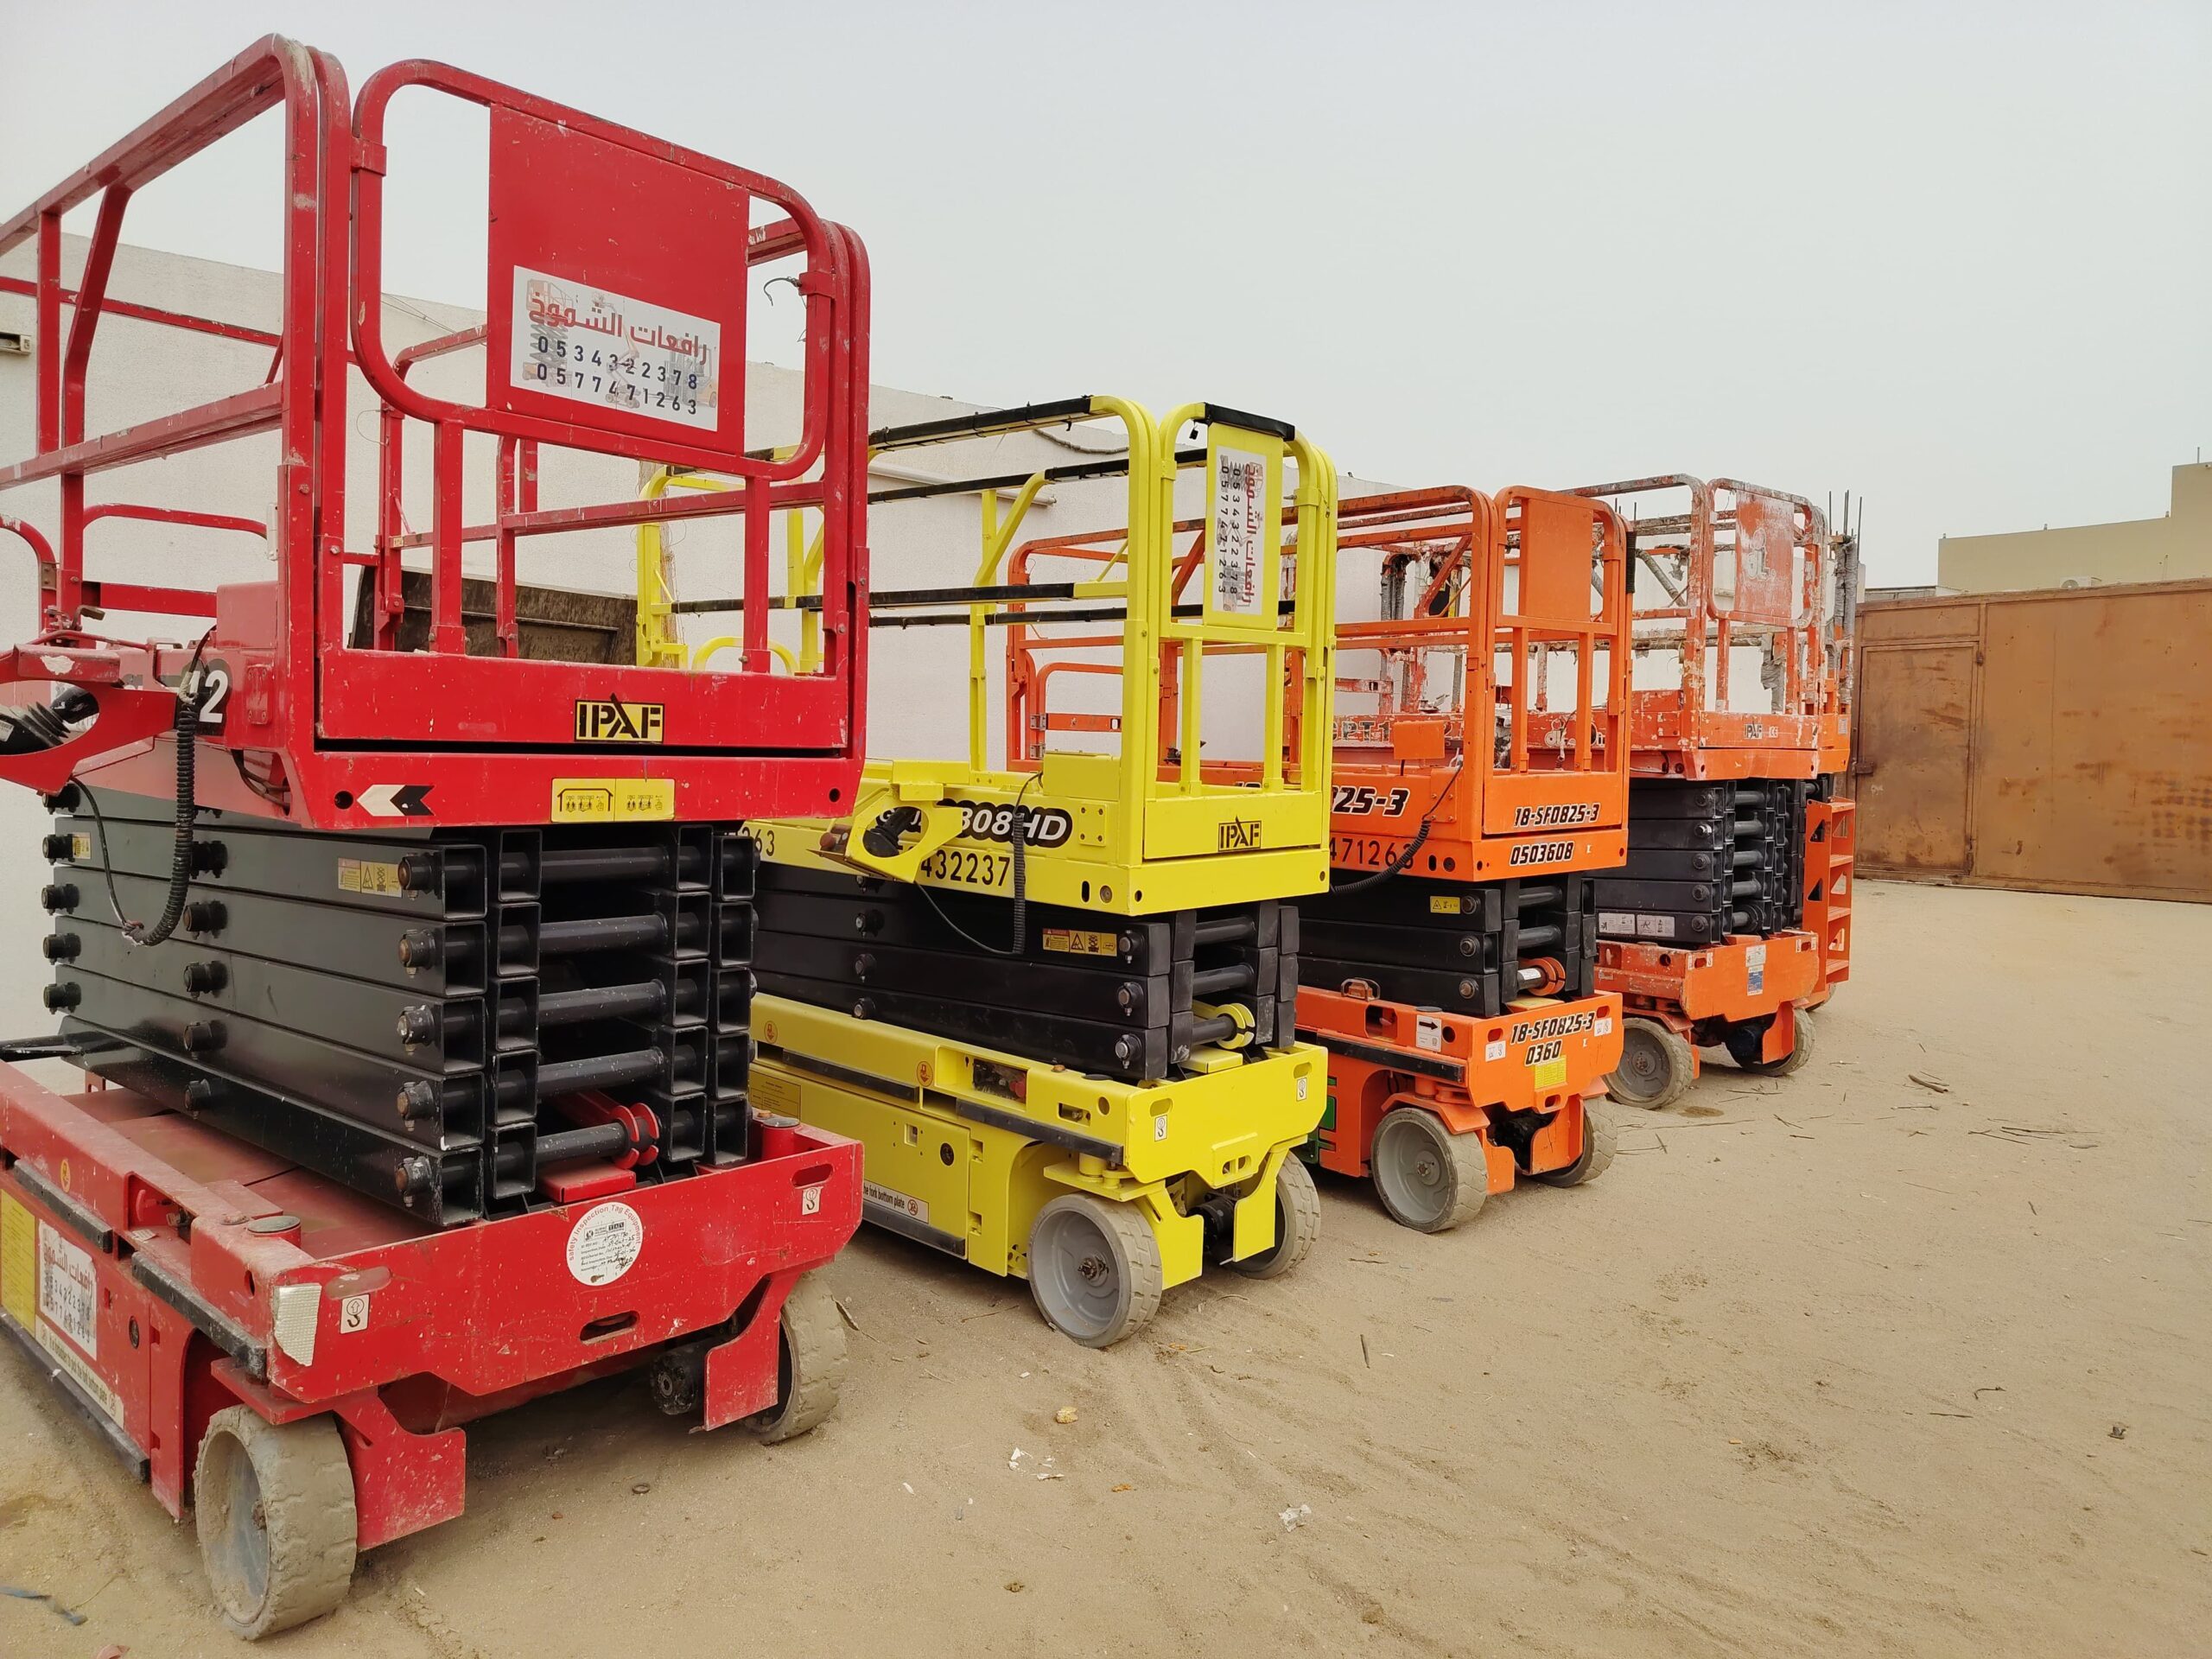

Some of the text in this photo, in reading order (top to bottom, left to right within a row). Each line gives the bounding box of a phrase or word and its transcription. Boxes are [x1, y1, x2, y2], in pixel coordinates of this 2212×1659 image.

[579, 692, 661, 739] IPAF
[1220, 814, 1260, 849] IPAF
[1524, 1039, 1562, 1067] 0360
